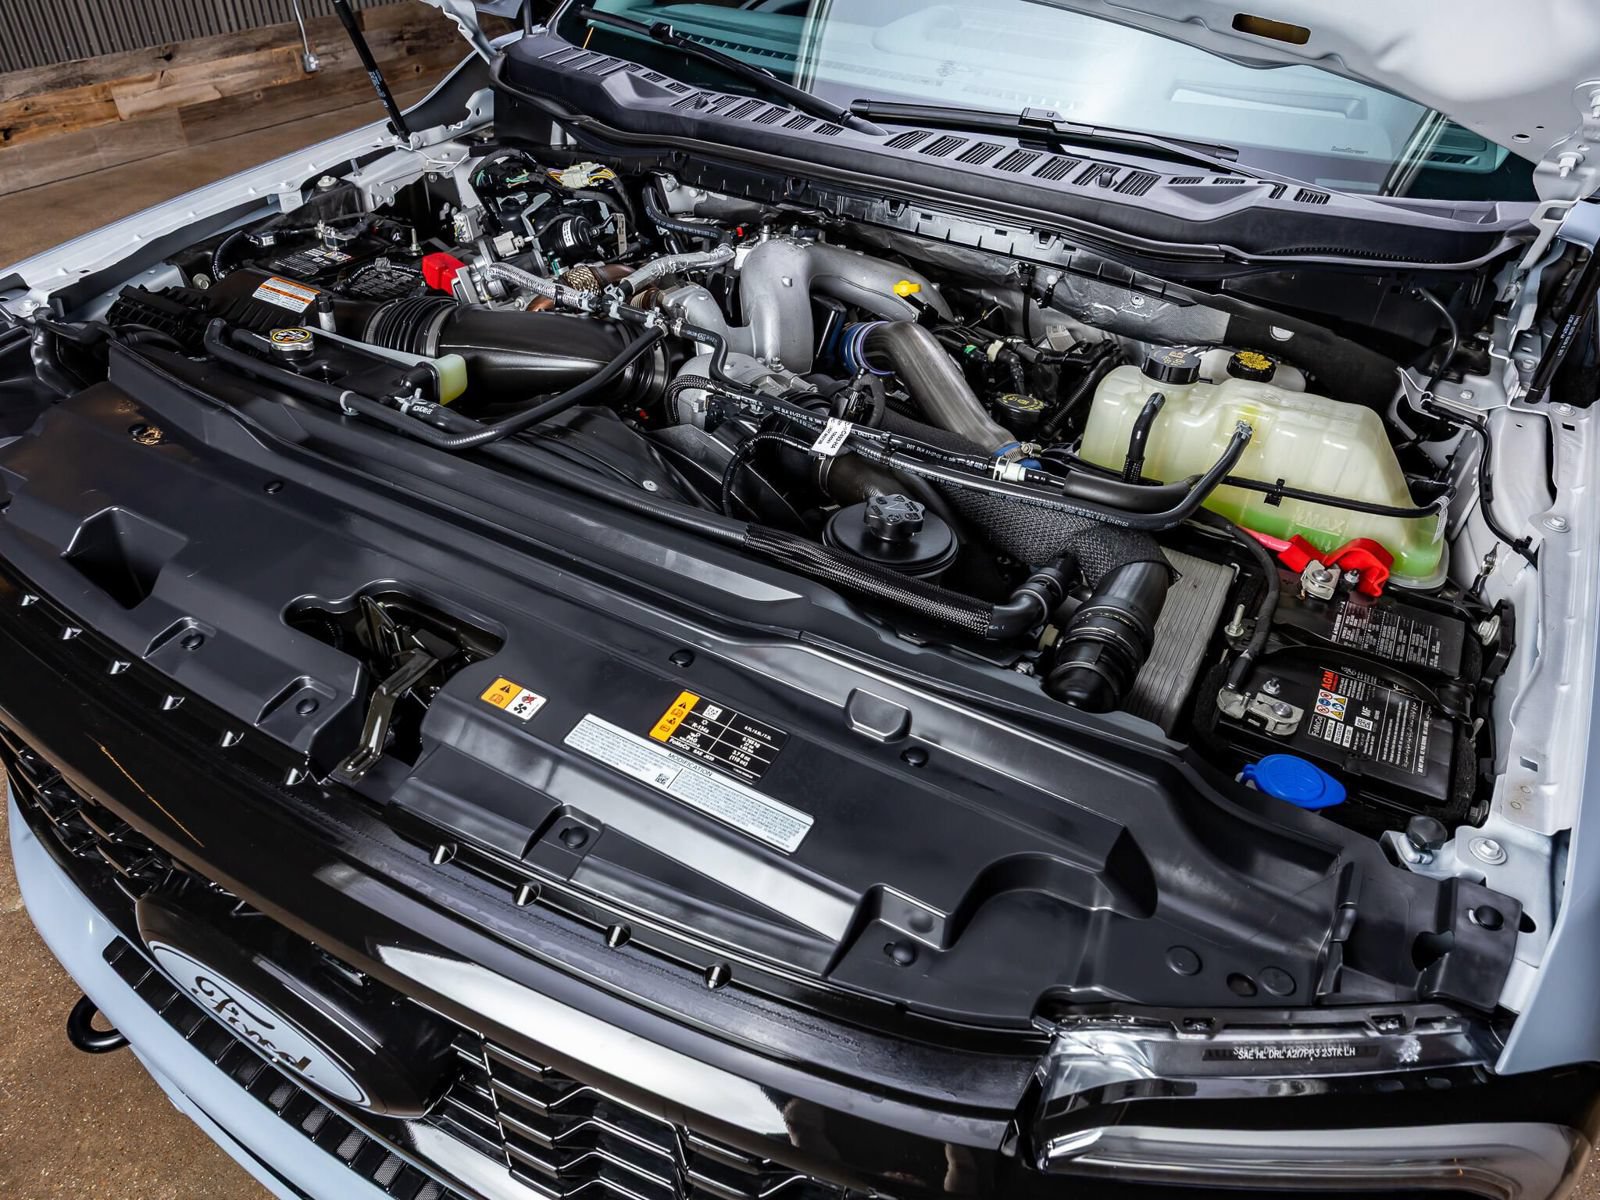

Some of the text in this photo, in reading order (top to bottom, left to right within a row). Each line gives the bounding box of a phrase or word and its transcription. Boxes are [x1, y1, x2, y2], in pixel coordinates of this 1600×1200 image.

[1321, 670, 1335, 691] AGM
[669, 737, 691, 751] FoMoCo
[692, 748, 704, 757] SAE
[667, 752, 713, 777] MODIFICATION
[191, 975, 315, 1079] Ford
[1237, 1050, 1254, 1060] SAE
[1255, 1051, 1267, 1060] HL
[1268, 1049, 1285, 1059] DRL
[1343, 1047, 1356, 1057] LH
